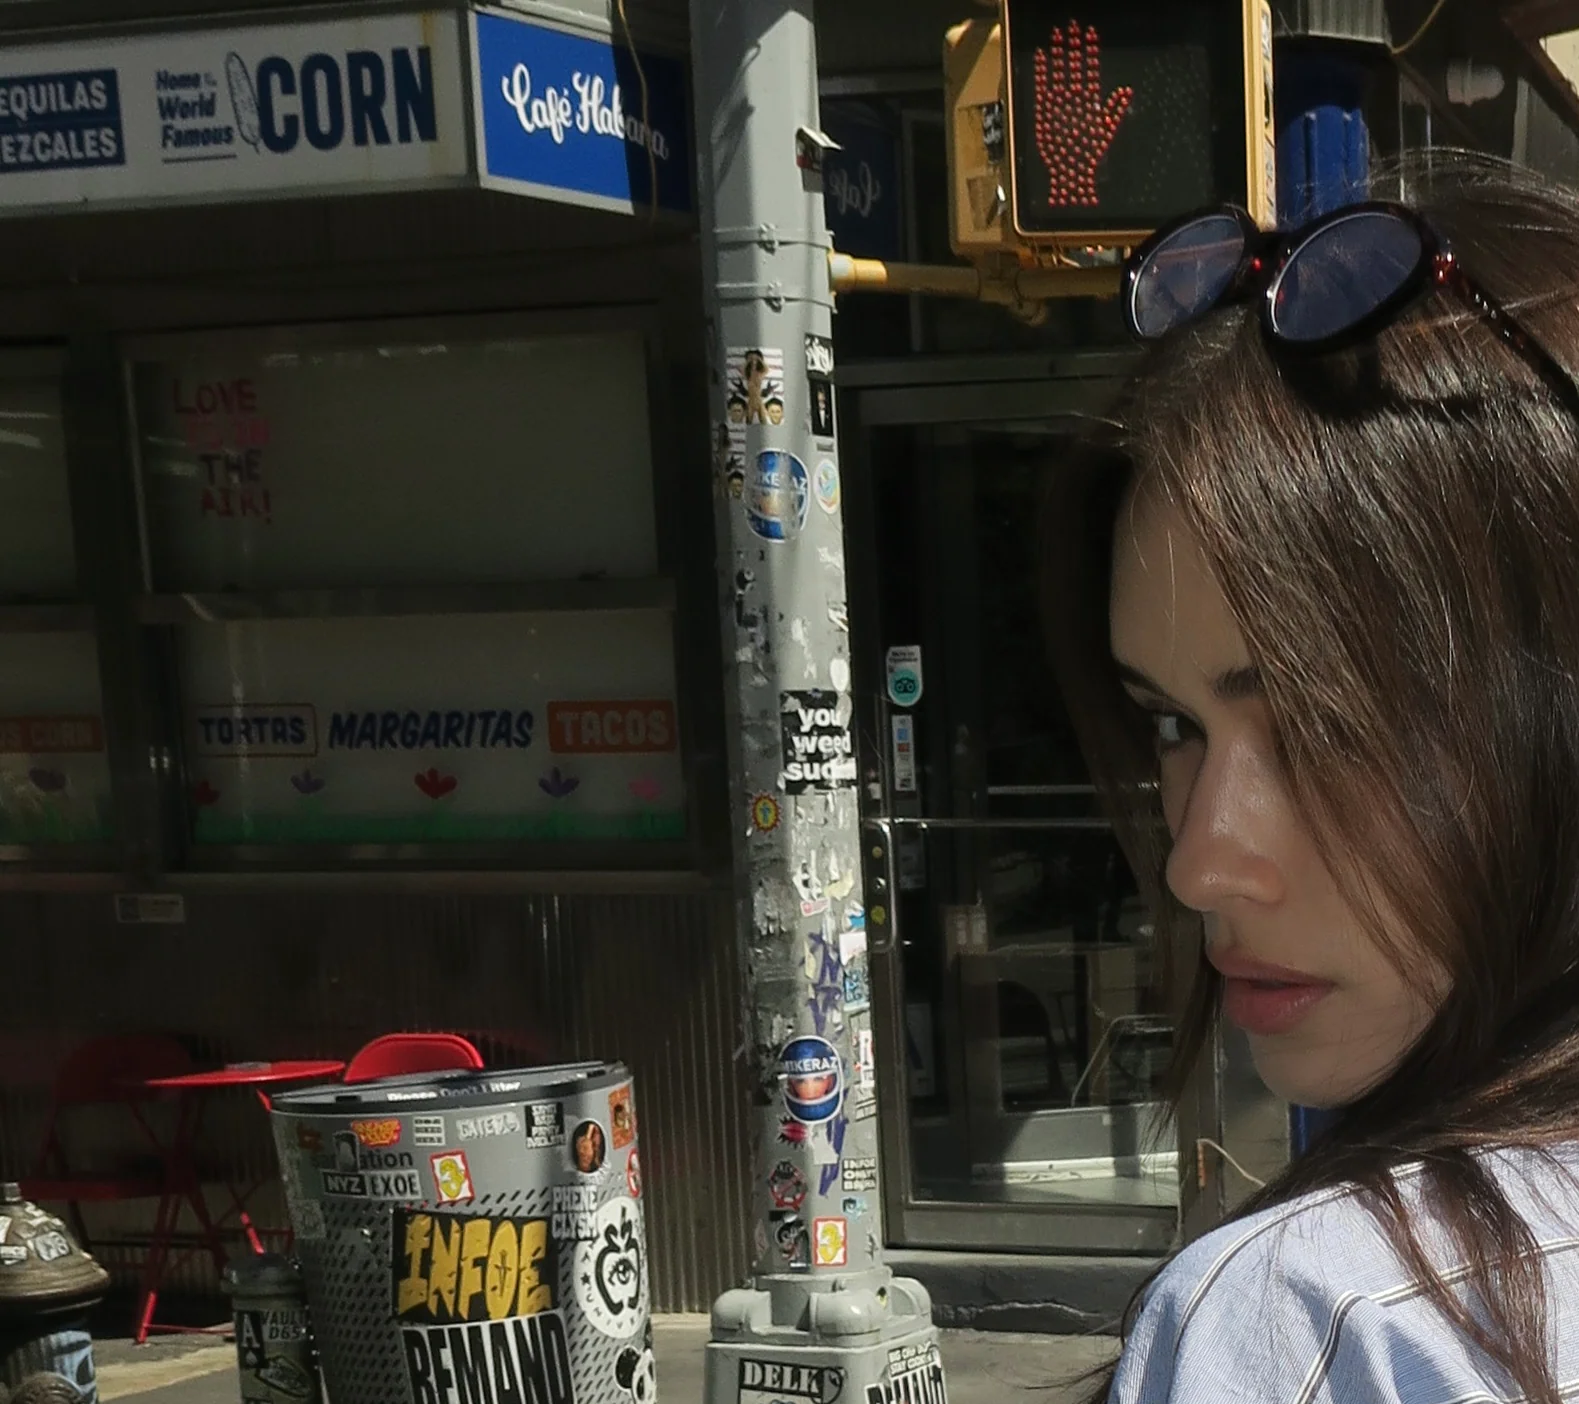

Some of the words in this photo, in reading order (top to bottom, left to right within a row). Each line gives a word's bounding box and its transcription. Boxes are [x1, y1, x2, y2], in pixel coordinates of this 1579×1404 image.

[156, 69, 201, 90] Home
[159, 92, 216, 120] World
[256, 46, 437, 154] CORN
[501, 62, 574, 145] Café
[572, 70, 670, 160] Habana
[161, 123, 234, 148] Famous
[173, 378, 257, 415] LOVE
[199, 448, 262, 485] THE
[199, 716, 307, 745] TORTAS
[329, 710, 535, 749] MARGARITAS
[555, 709, 670, 747] TACOS
[327, 1174, 362, 1194] NYZ
[371, 1174, 419, 1196] EXOE
[398, 1213, 552, 1321] INFOE
